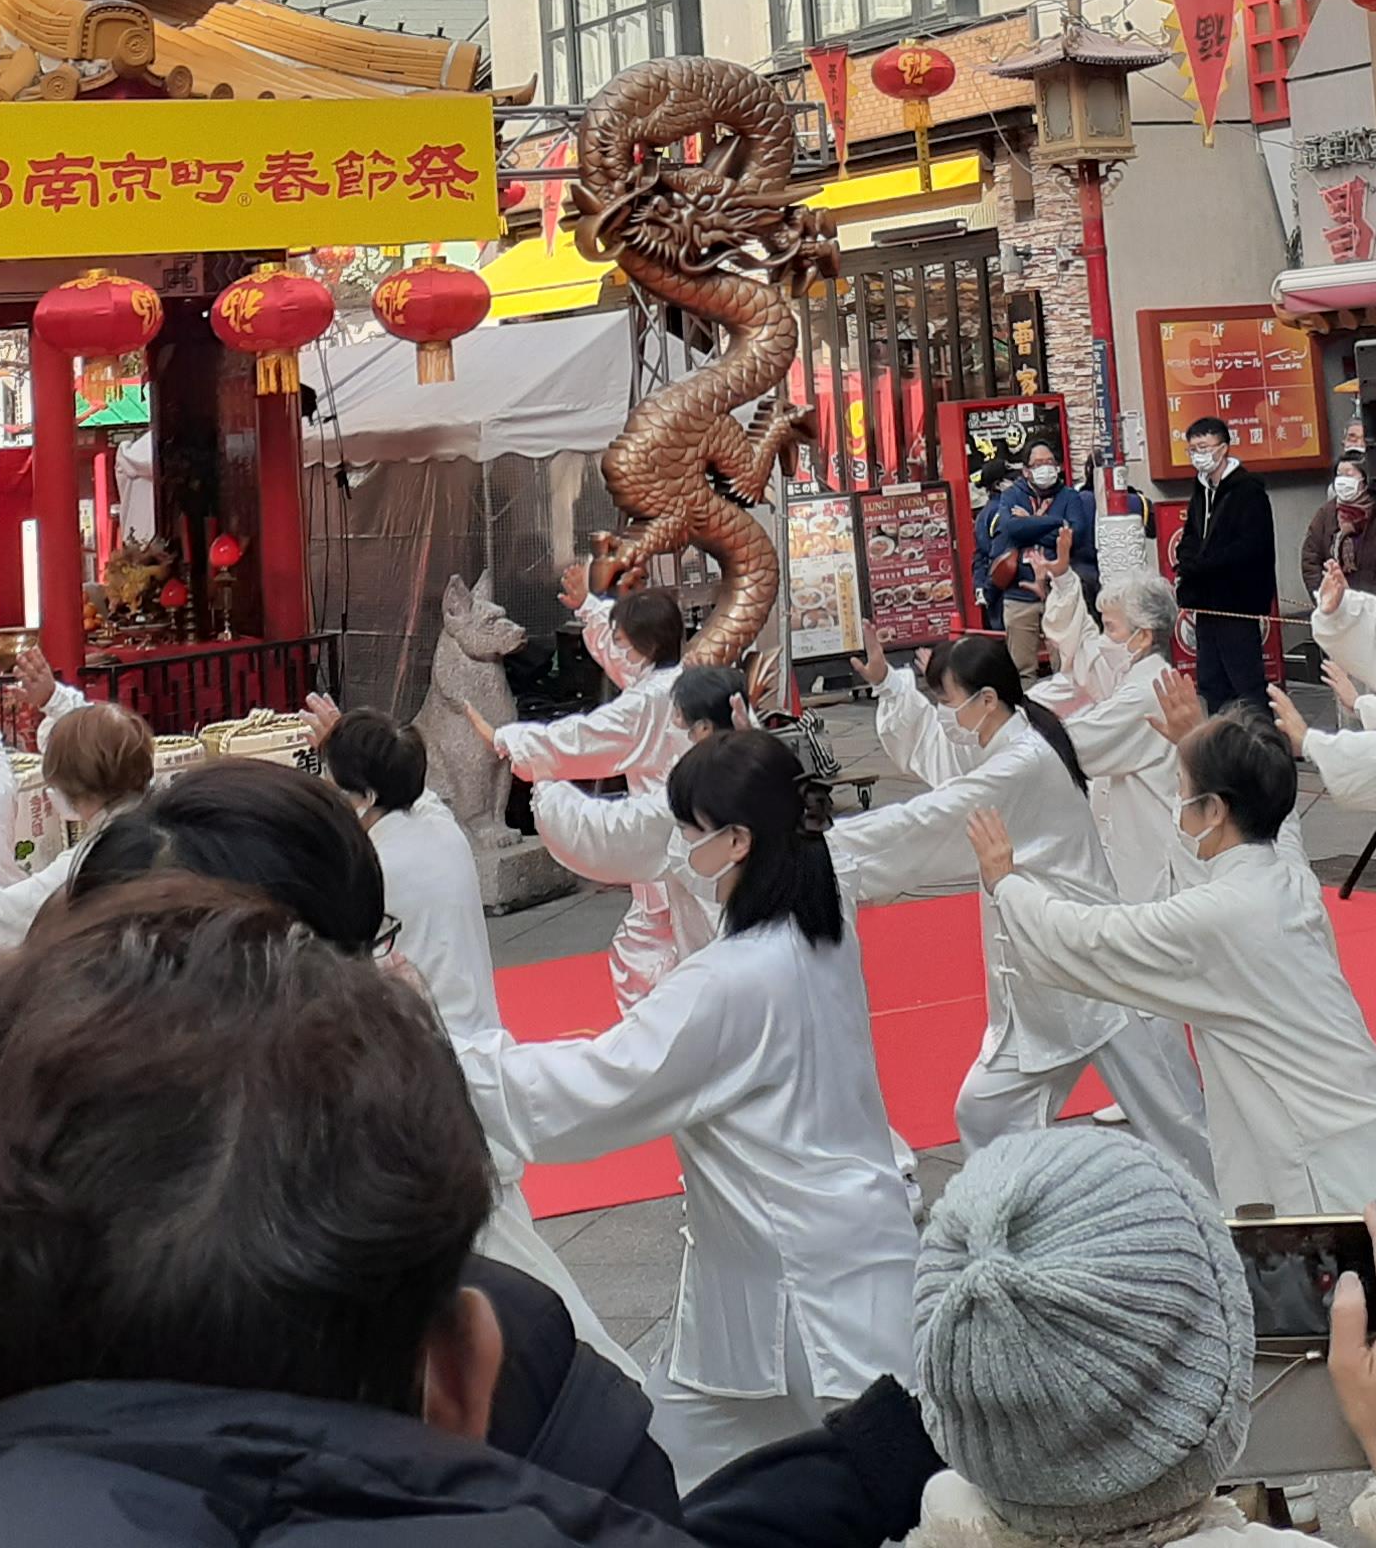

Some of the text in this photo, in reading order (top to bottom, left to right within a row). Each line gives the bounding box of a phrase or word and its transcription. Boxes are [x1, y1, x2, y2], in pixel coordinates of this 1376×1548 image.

[1215, 358, 1263, 370] サンセール
[864, 500, 895, 512] LUNCH
